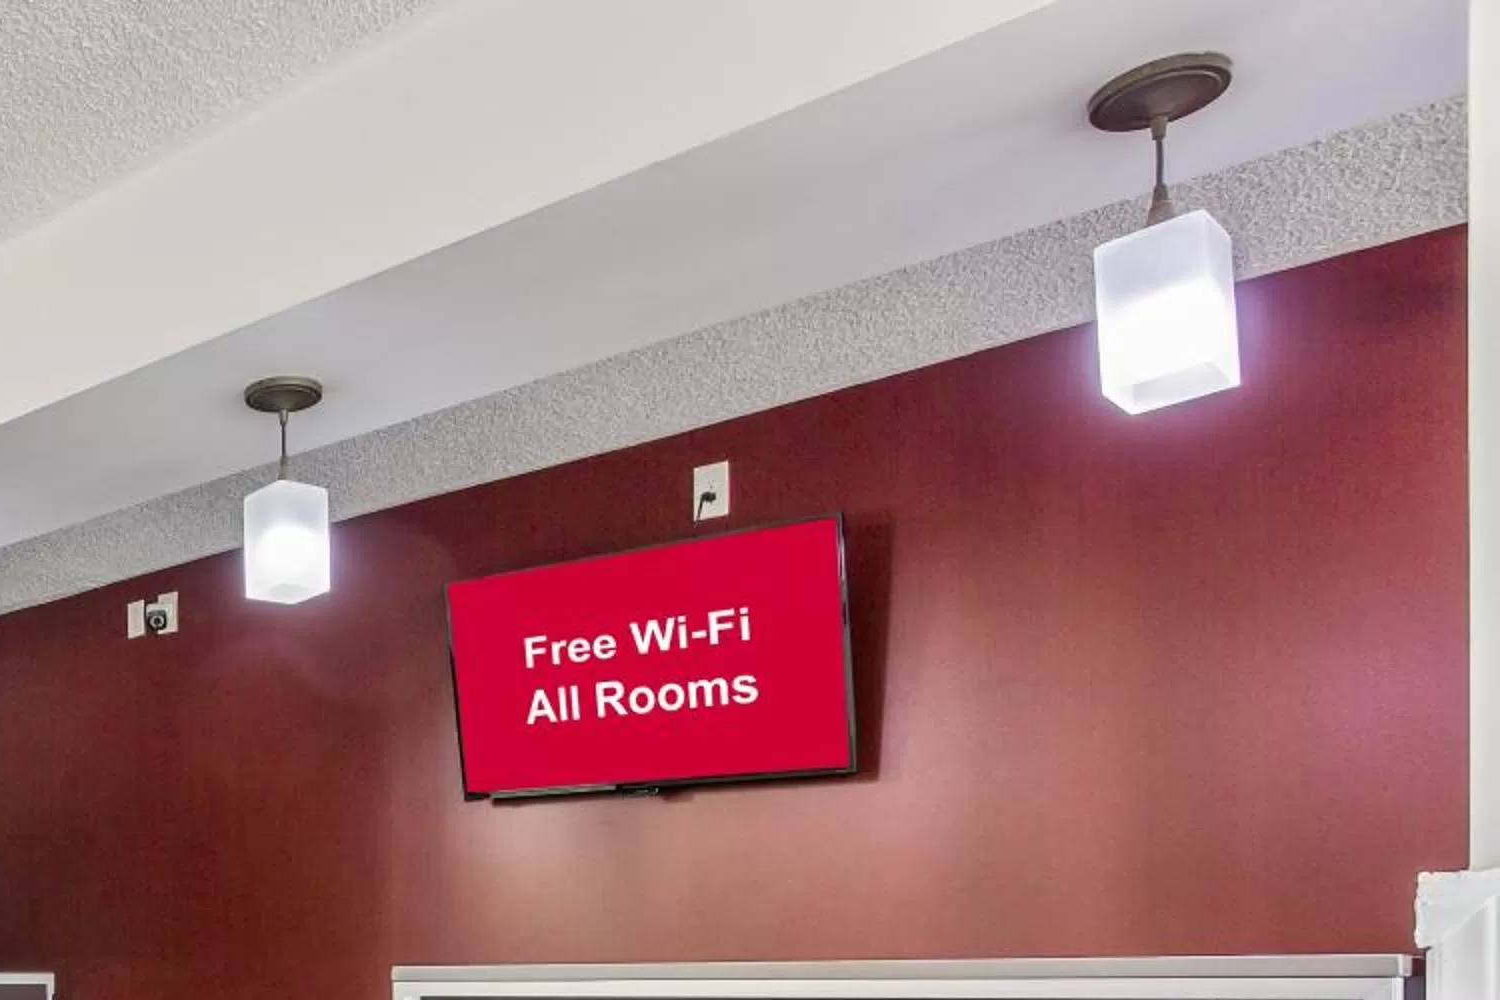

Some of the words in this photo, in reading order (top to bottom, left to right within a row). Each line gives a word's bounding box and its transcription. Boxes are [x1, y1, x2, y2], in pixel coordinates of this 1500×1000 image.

[524, 634, 617, 669] Free
[630, 607, 751, 655] Wi-Fi
[527, 685, 581, 725] All
[595, 675, 759, 718] Rooms
